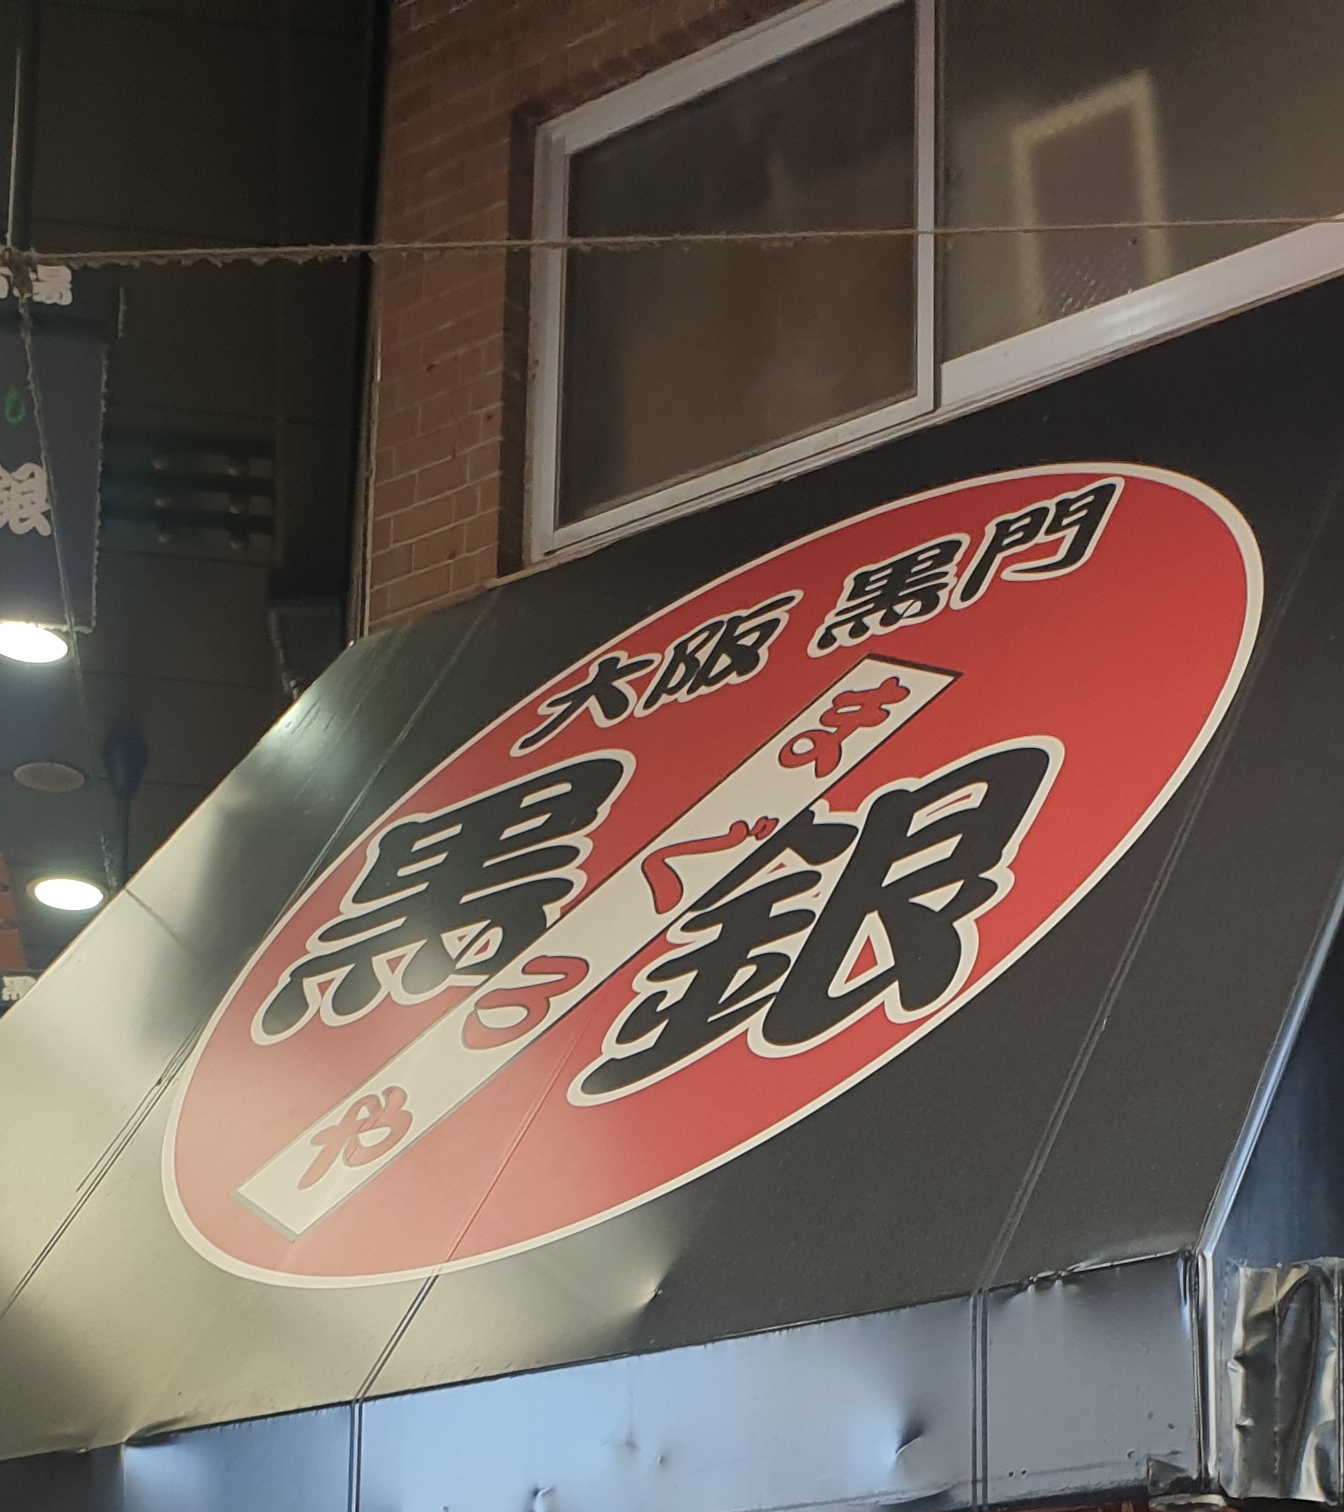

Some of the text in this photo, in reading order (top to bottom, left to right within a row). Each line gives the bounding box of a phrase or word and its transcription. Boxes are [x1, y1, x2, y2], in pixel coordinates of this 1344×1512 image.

[508, 476, 1124, 759] 大阪 黒門
[296, 673, 912, 1191] まぐろや
